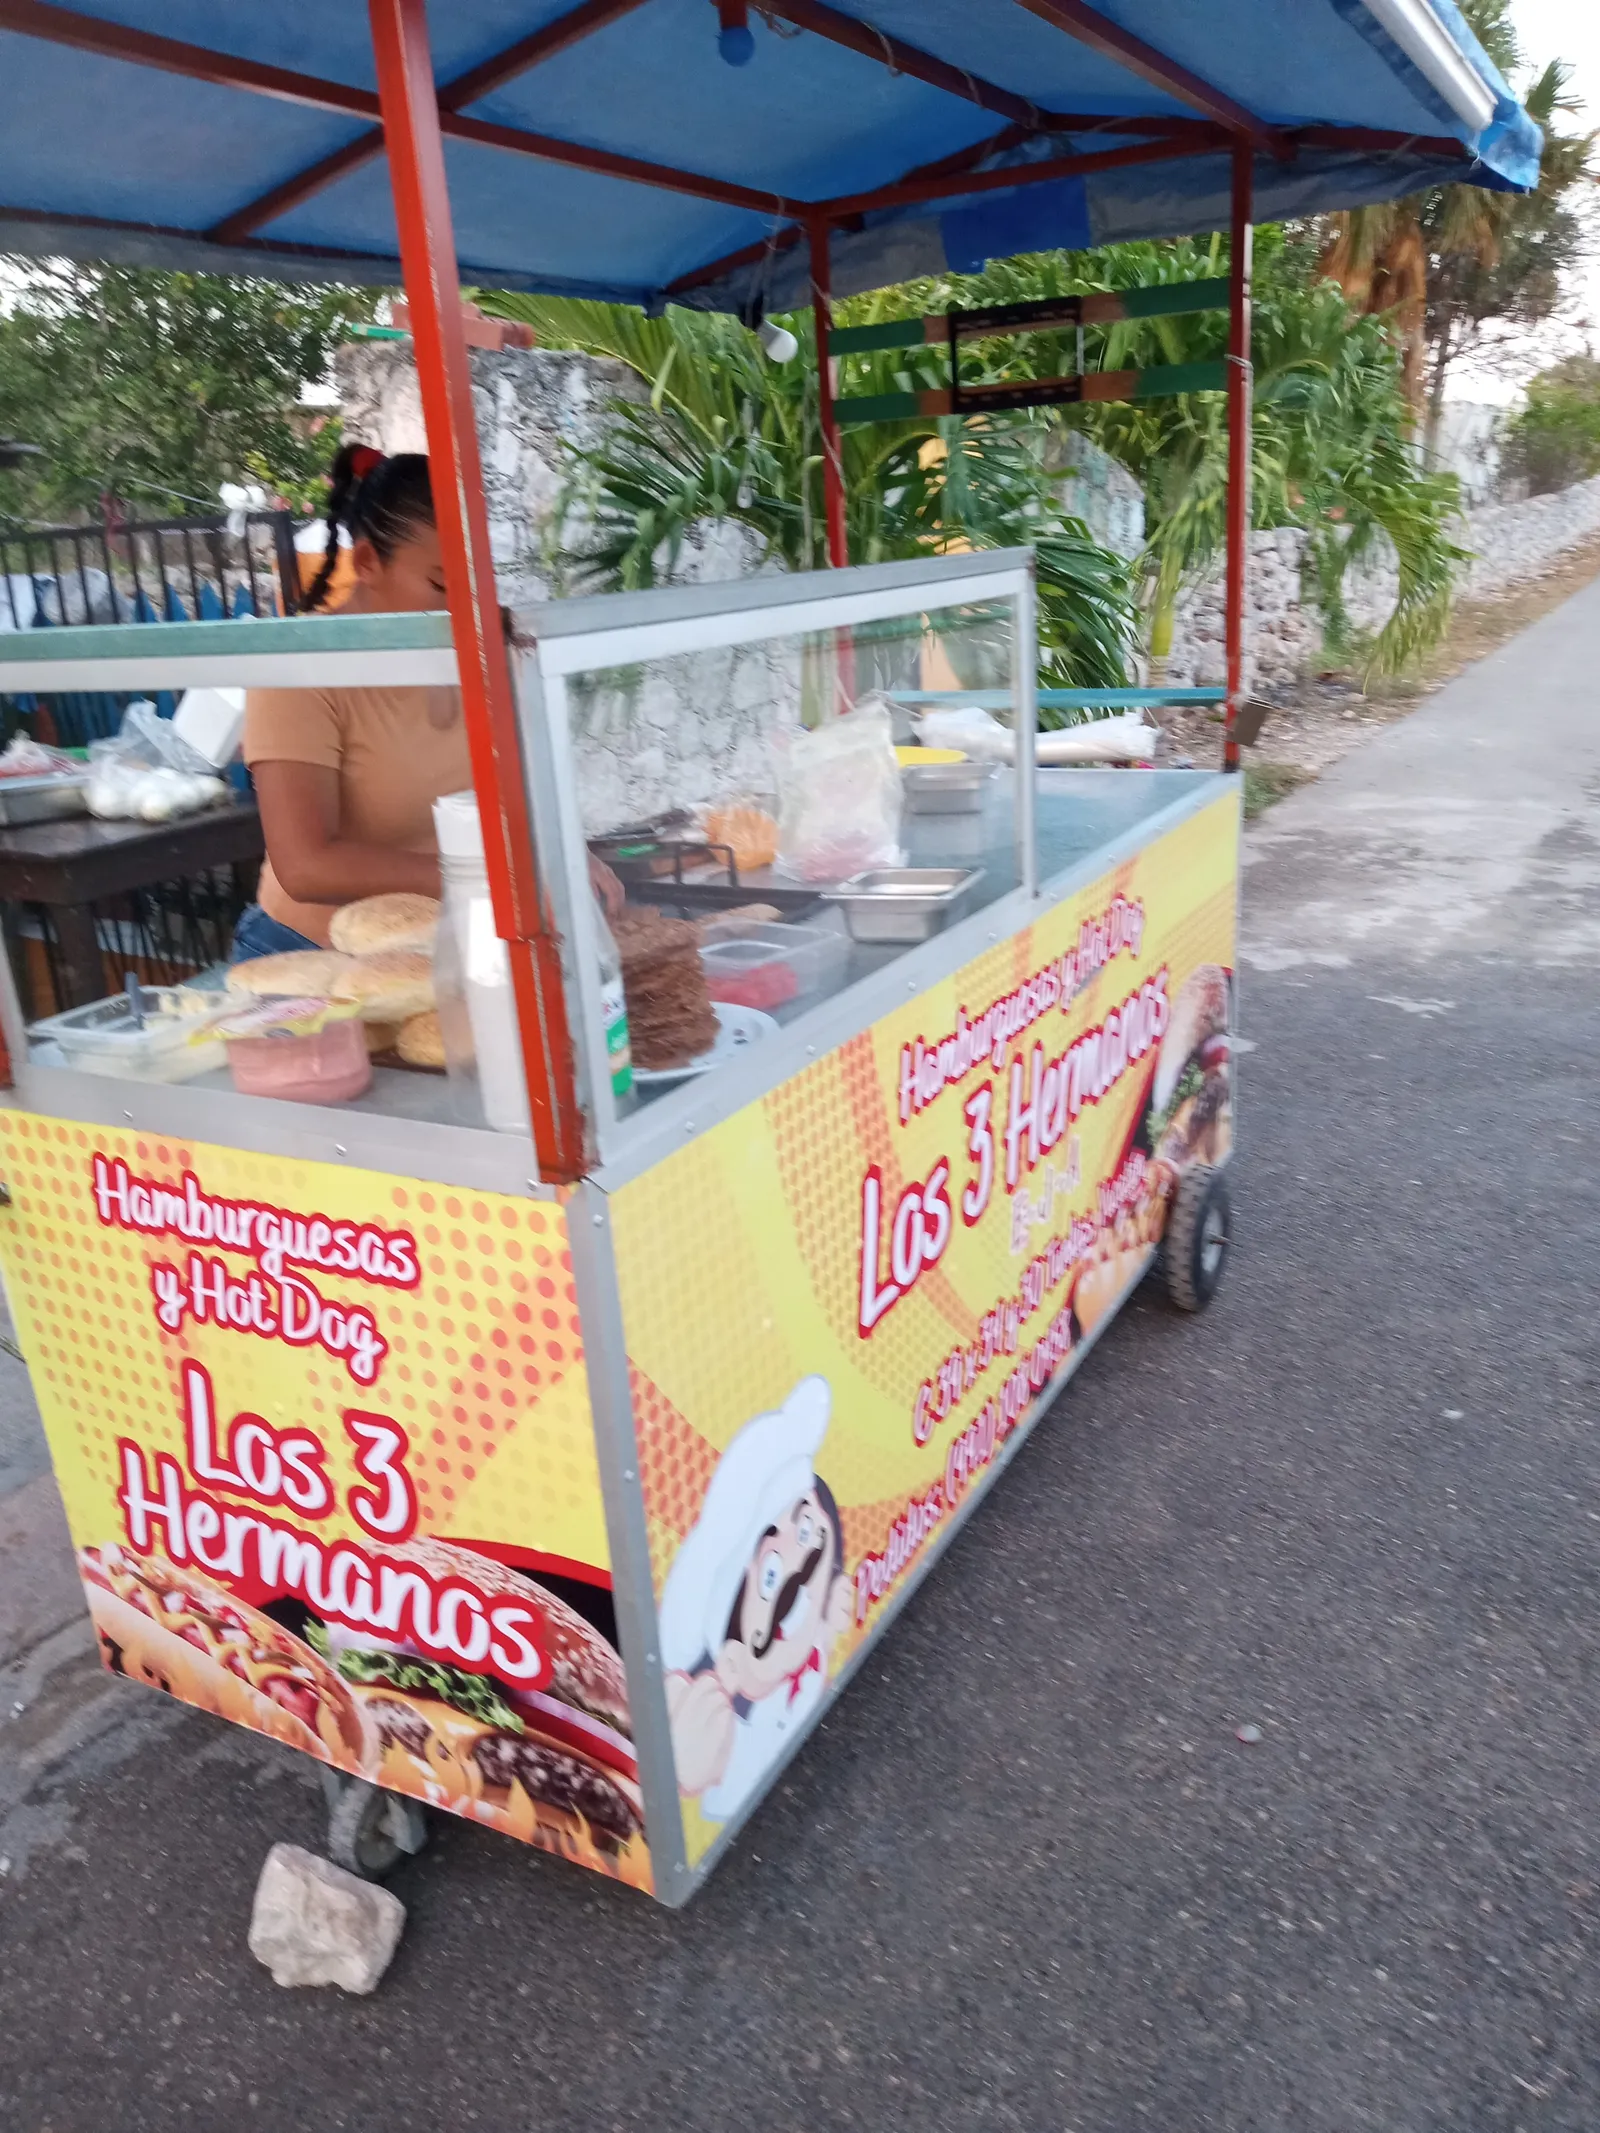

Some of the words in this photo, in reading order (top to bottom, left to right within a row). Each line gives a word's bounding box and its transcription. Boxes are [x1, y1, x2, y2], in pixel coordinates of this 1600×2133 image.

[899, 963, 1060, 1121] Hamburguesas
[1062, 952, 1080, 1010] y
[92, 1156, 416, 1282] Hamburguesas
[860, 1159, 950, 1331] Los
[962, 1086, 993, 1219] 3
[1004, 967, 1169, 1187] Hermanos
[154, 1263, 186, 1325] y
[191, 1259, 277, 1333] Hot
[281, 1276, 385, 1379] Dog
[185, 1366, 328, 1512] Los
[346, 1421, 409, 1534] 3
[122, 1445, 543, 1685] Hermanos
